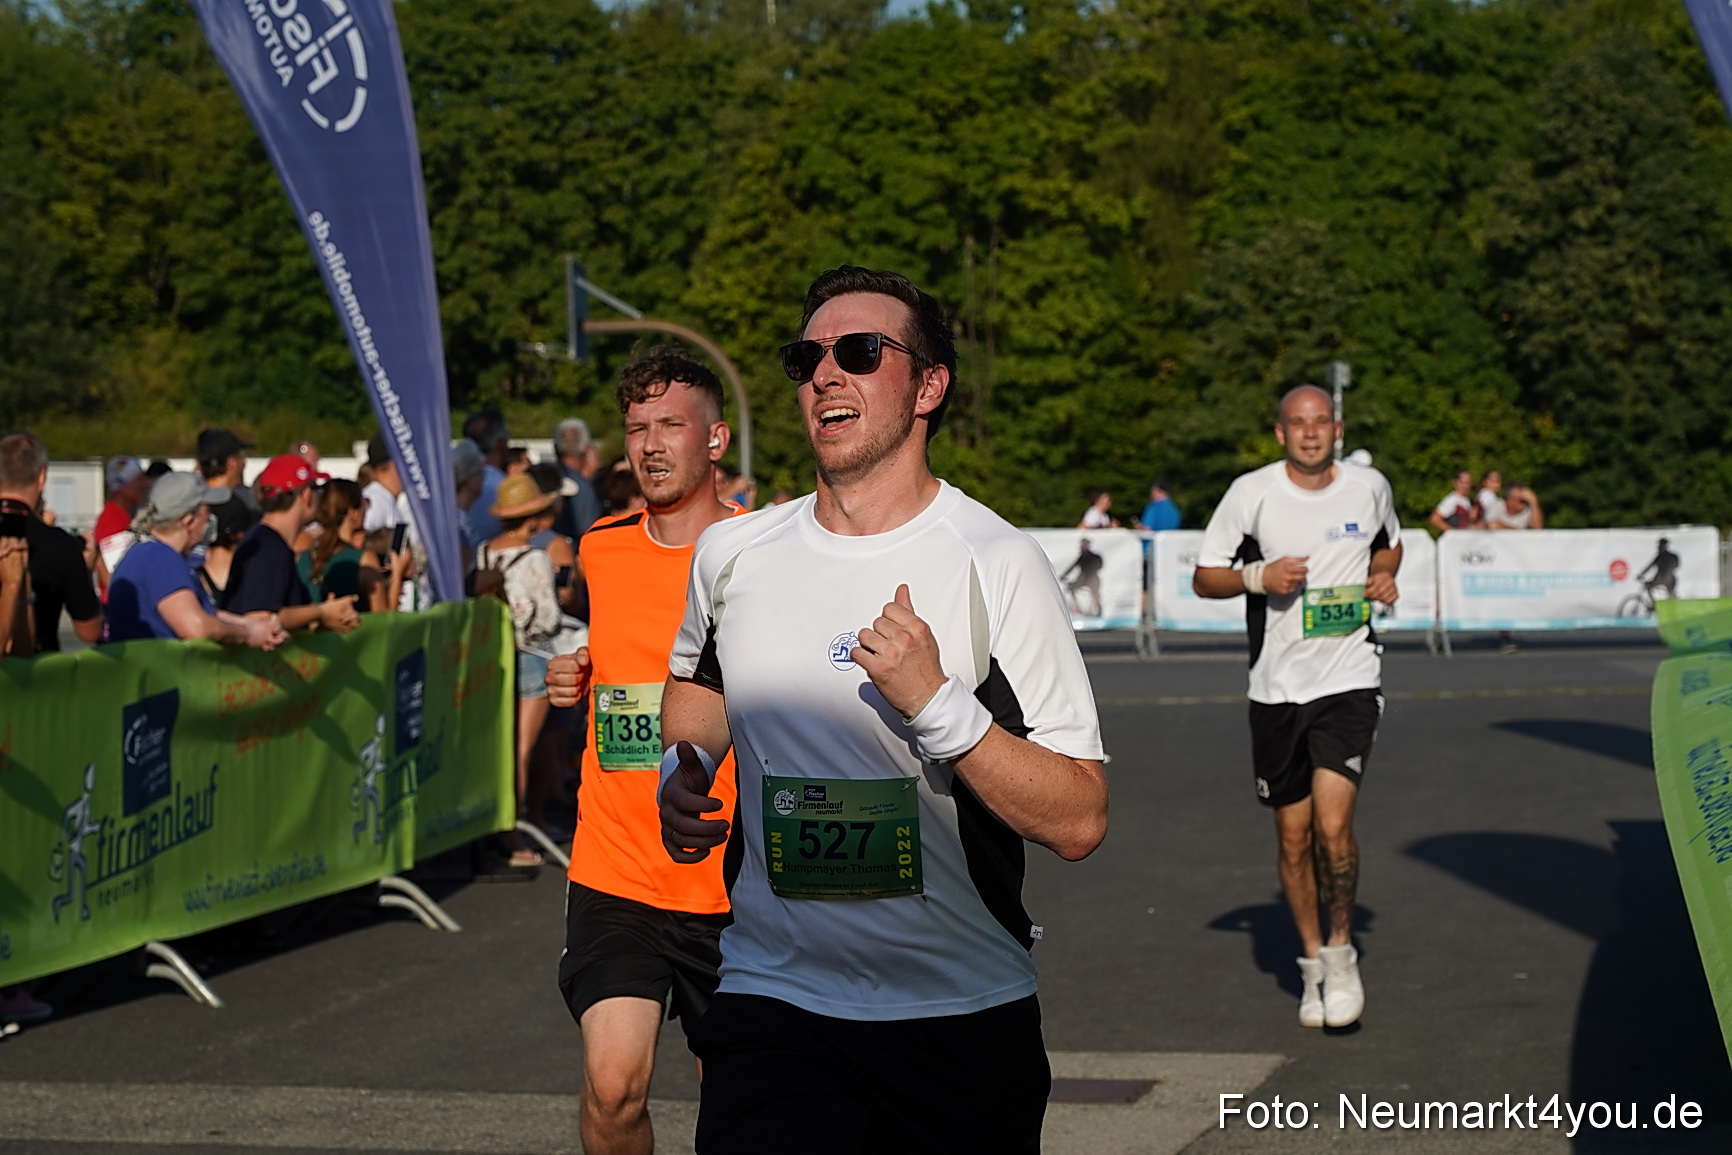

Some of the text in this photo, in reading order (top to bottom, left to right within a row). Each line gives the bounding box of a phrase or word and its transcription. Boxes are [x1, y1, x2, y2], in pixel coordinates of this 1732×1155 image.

[1320, 602, 1355, 622] 534
[797, 800, 844, 810] Firmenlauf
[94, 763, 219, 888] firmenlauf
[798, 821, 876, 860] 527
[770, 832, 784, 873] RUN
[784, 861, 898, 876] Humpmayer Thomas
[896, 825, 914, 880] 2022
